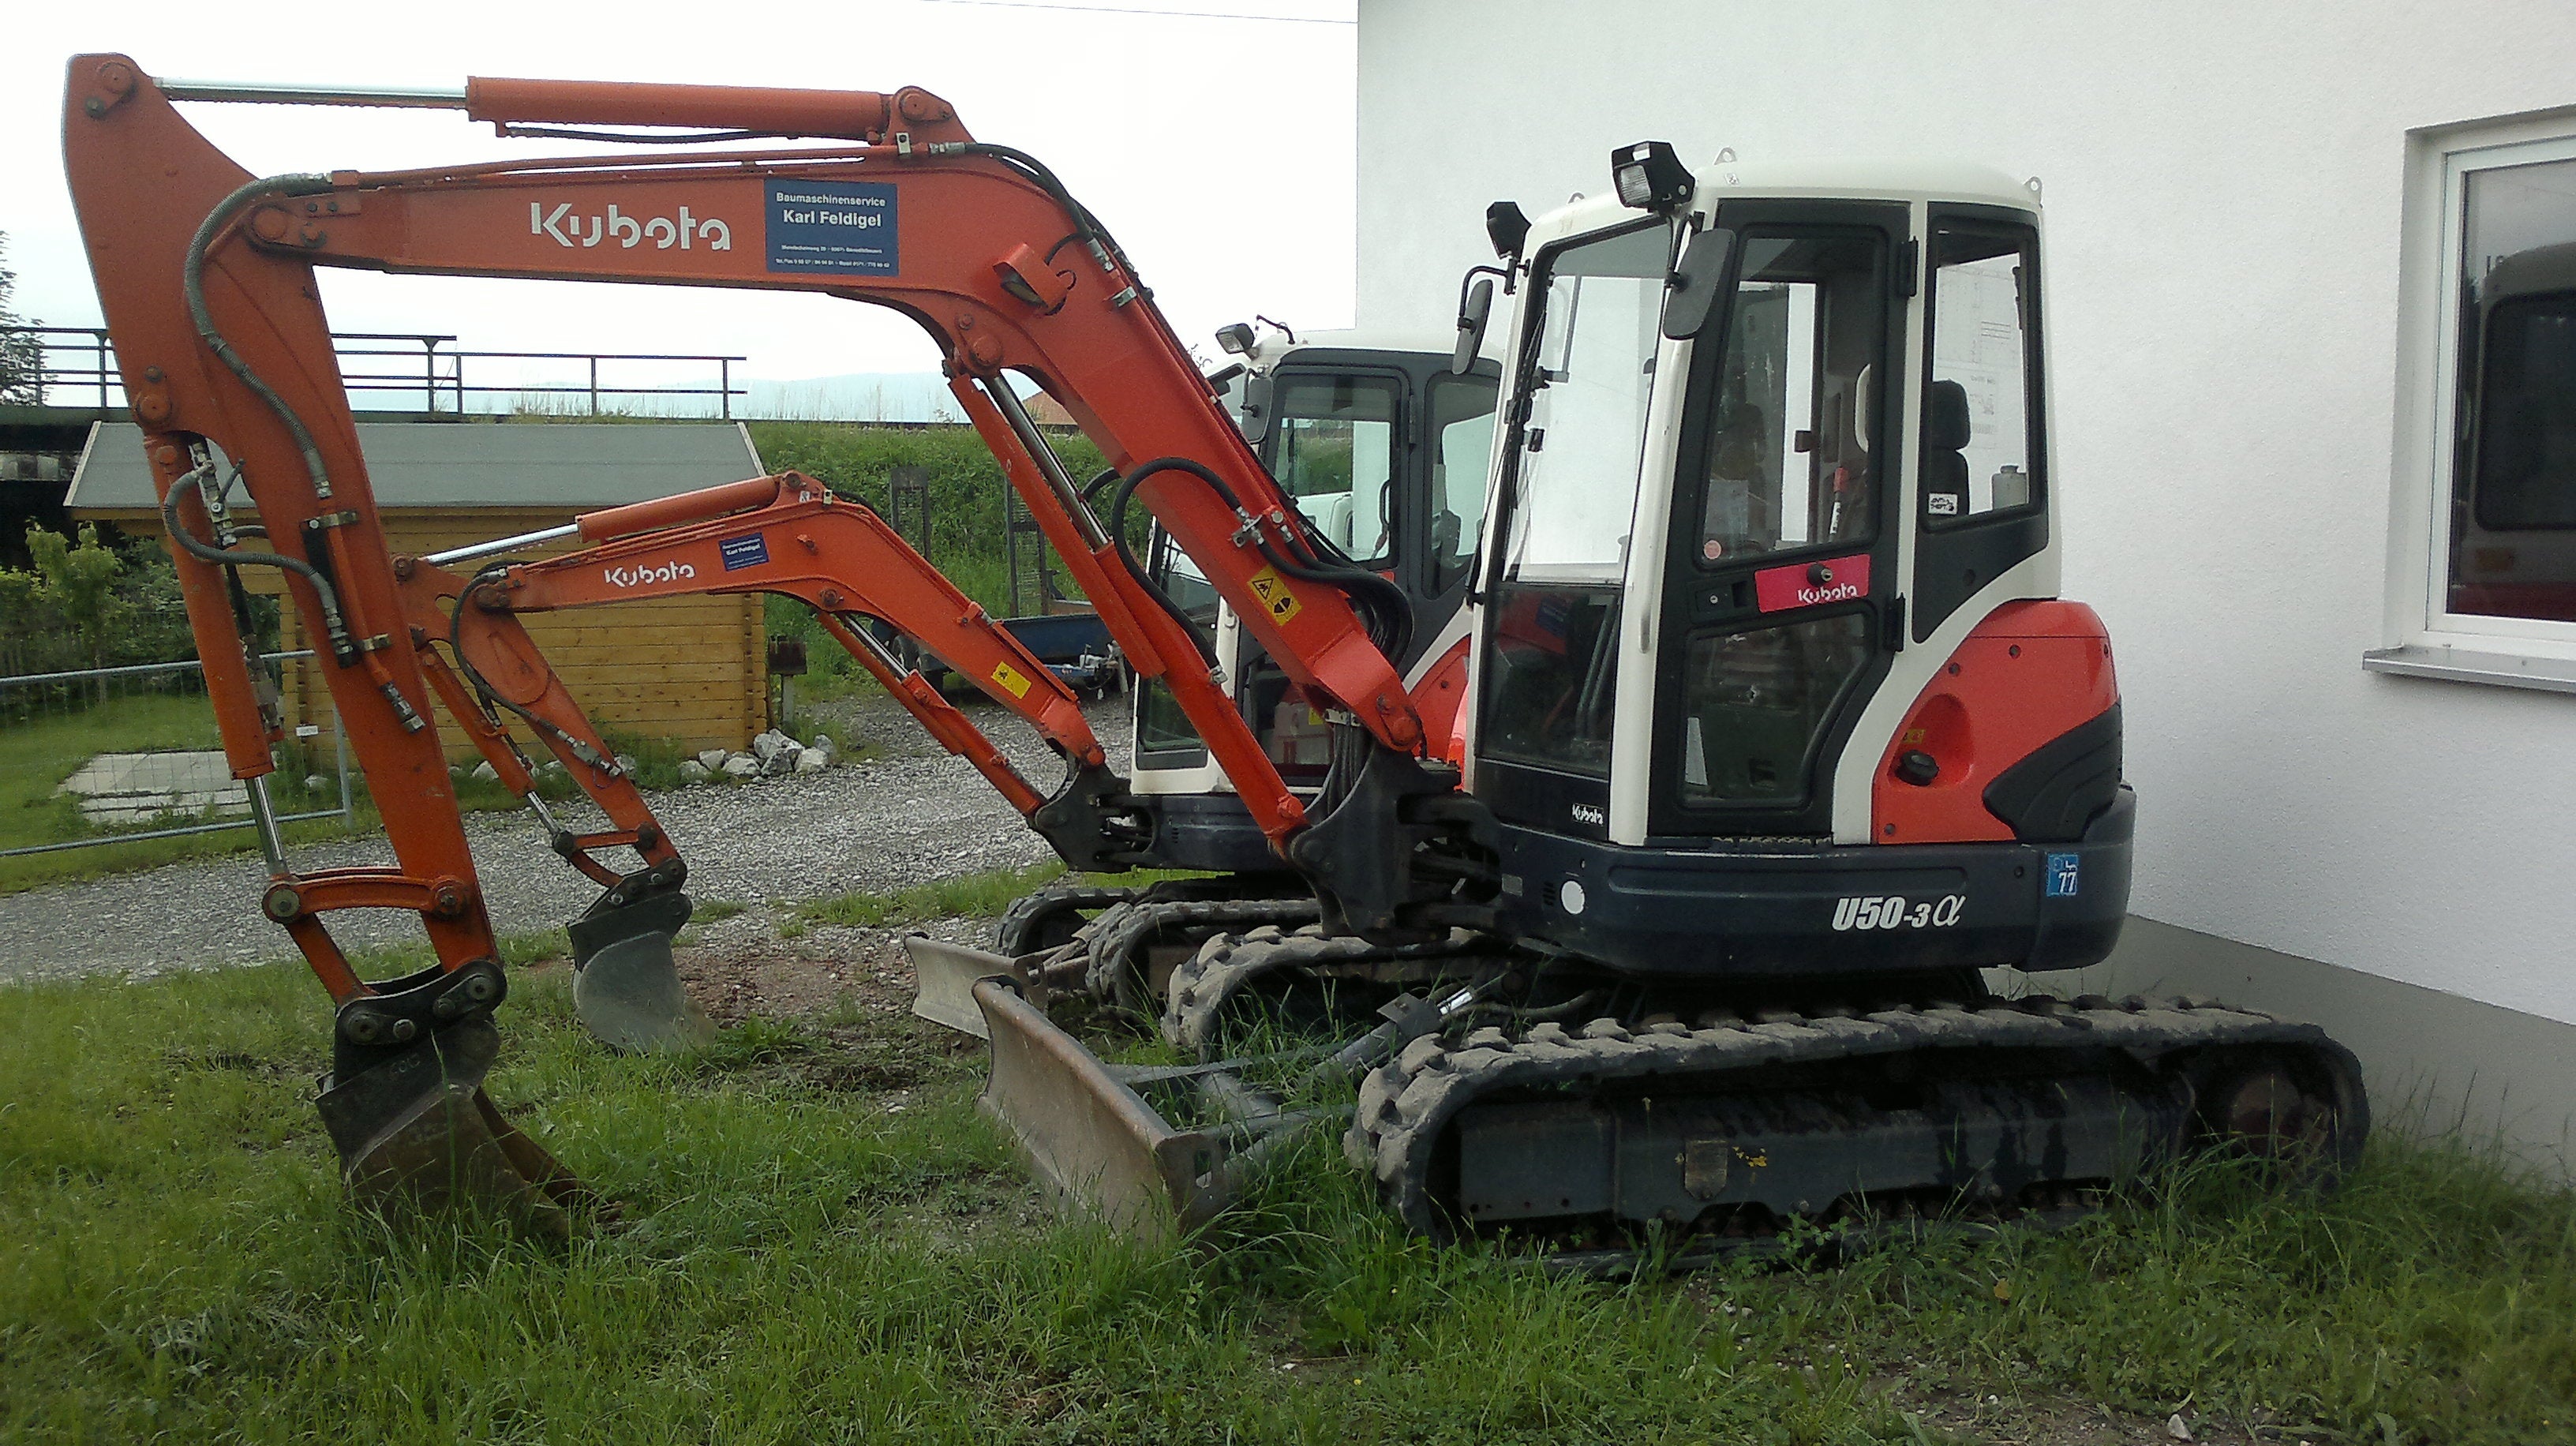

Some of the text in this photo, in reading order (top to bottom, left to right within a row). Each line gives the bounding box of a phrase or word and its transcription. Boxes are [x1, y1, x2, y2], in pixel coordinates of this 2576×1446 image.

[776, 192, 886, 207] Baumaschinenservice
[530, 202, 731, 250] Kubota
[783, 209, 882, 229] Karl Feldigel
[605, 560, 695, 587] Kubota
[1797, 583, 1858, 604] Kubota
[1571, 804, 1604, 825] Kubota
